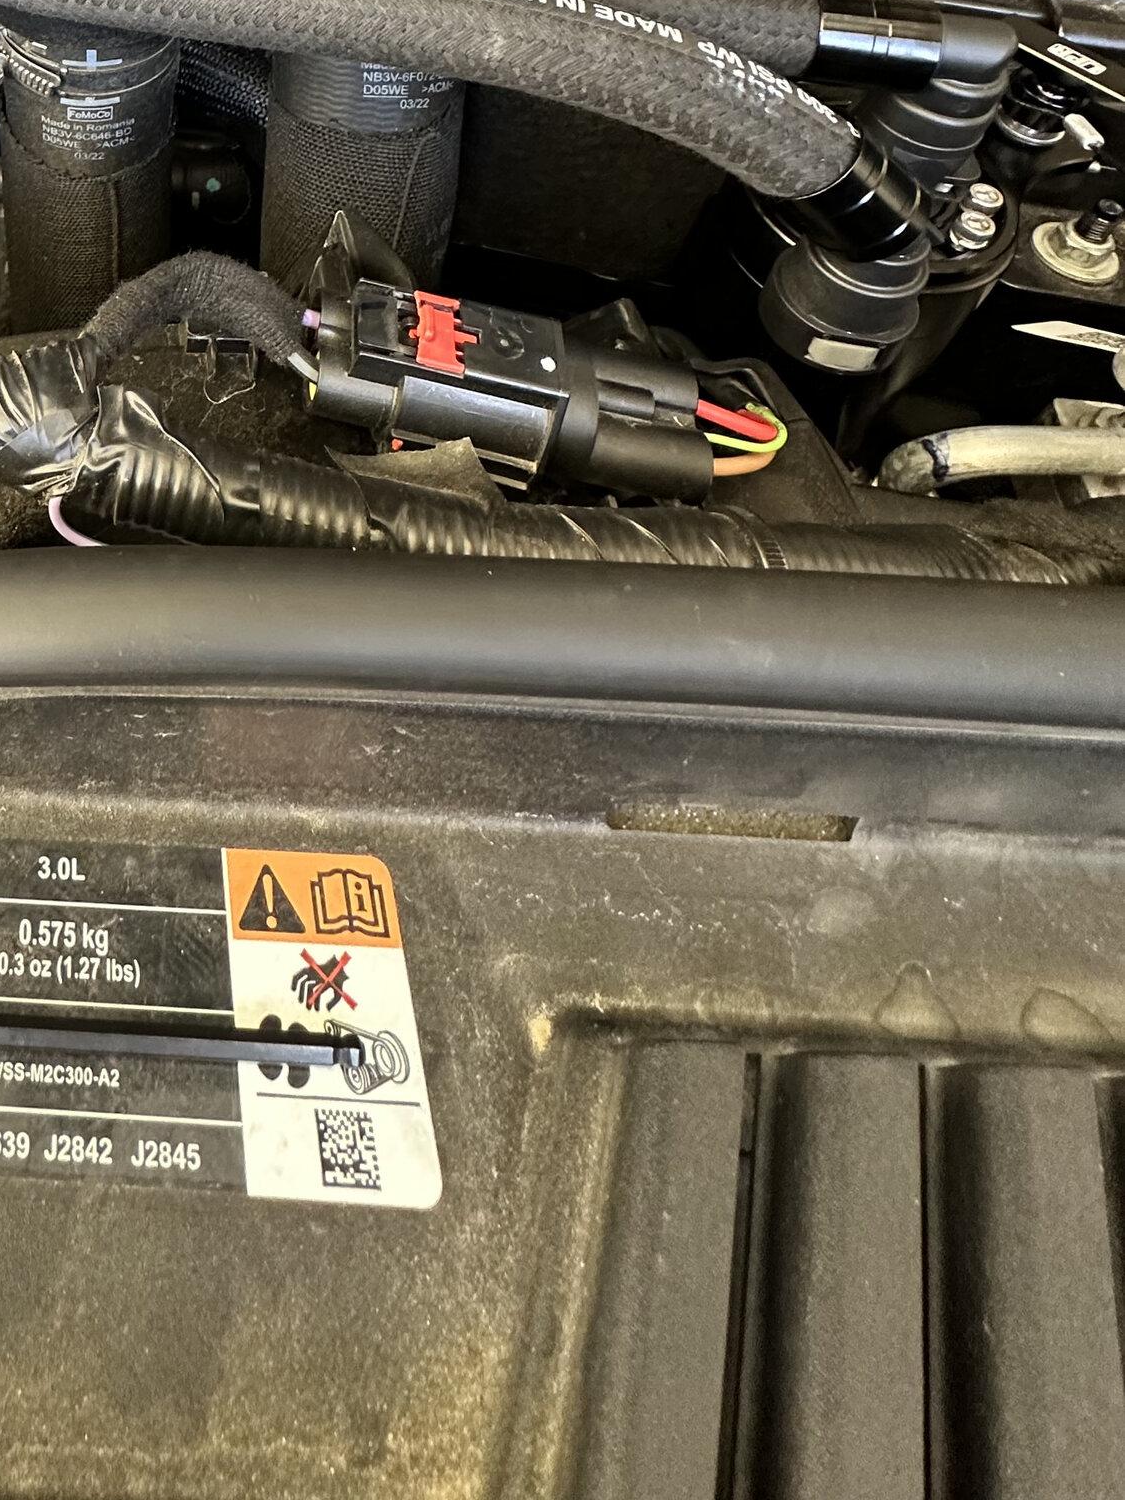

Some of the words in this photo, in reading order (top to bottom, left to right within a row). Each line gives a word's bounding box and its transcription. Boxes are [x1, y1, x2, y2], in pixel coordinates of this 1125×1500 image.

[593, 3, 684, 44] MADE
[697, 41, 745, 70] WP
[41, 115, 71, 130] Made
[73, 123, 83, 131] in
[86, 118, 135, 132] Romania
[68, 110, 111, 120] FoMoCo
[37, 855, 86, 881] 3.0L
[18, 918, 76, 948] 0.575
[82, 921, 109, 956] kg
[29, 958, 52, 978] oz
[56, 955, 101, 985] (1.27
[106, 958, 141, 989] lbs)
[43, 1133, 114, 1165] J2842
[130, 1139, 202, 1171] J2845
